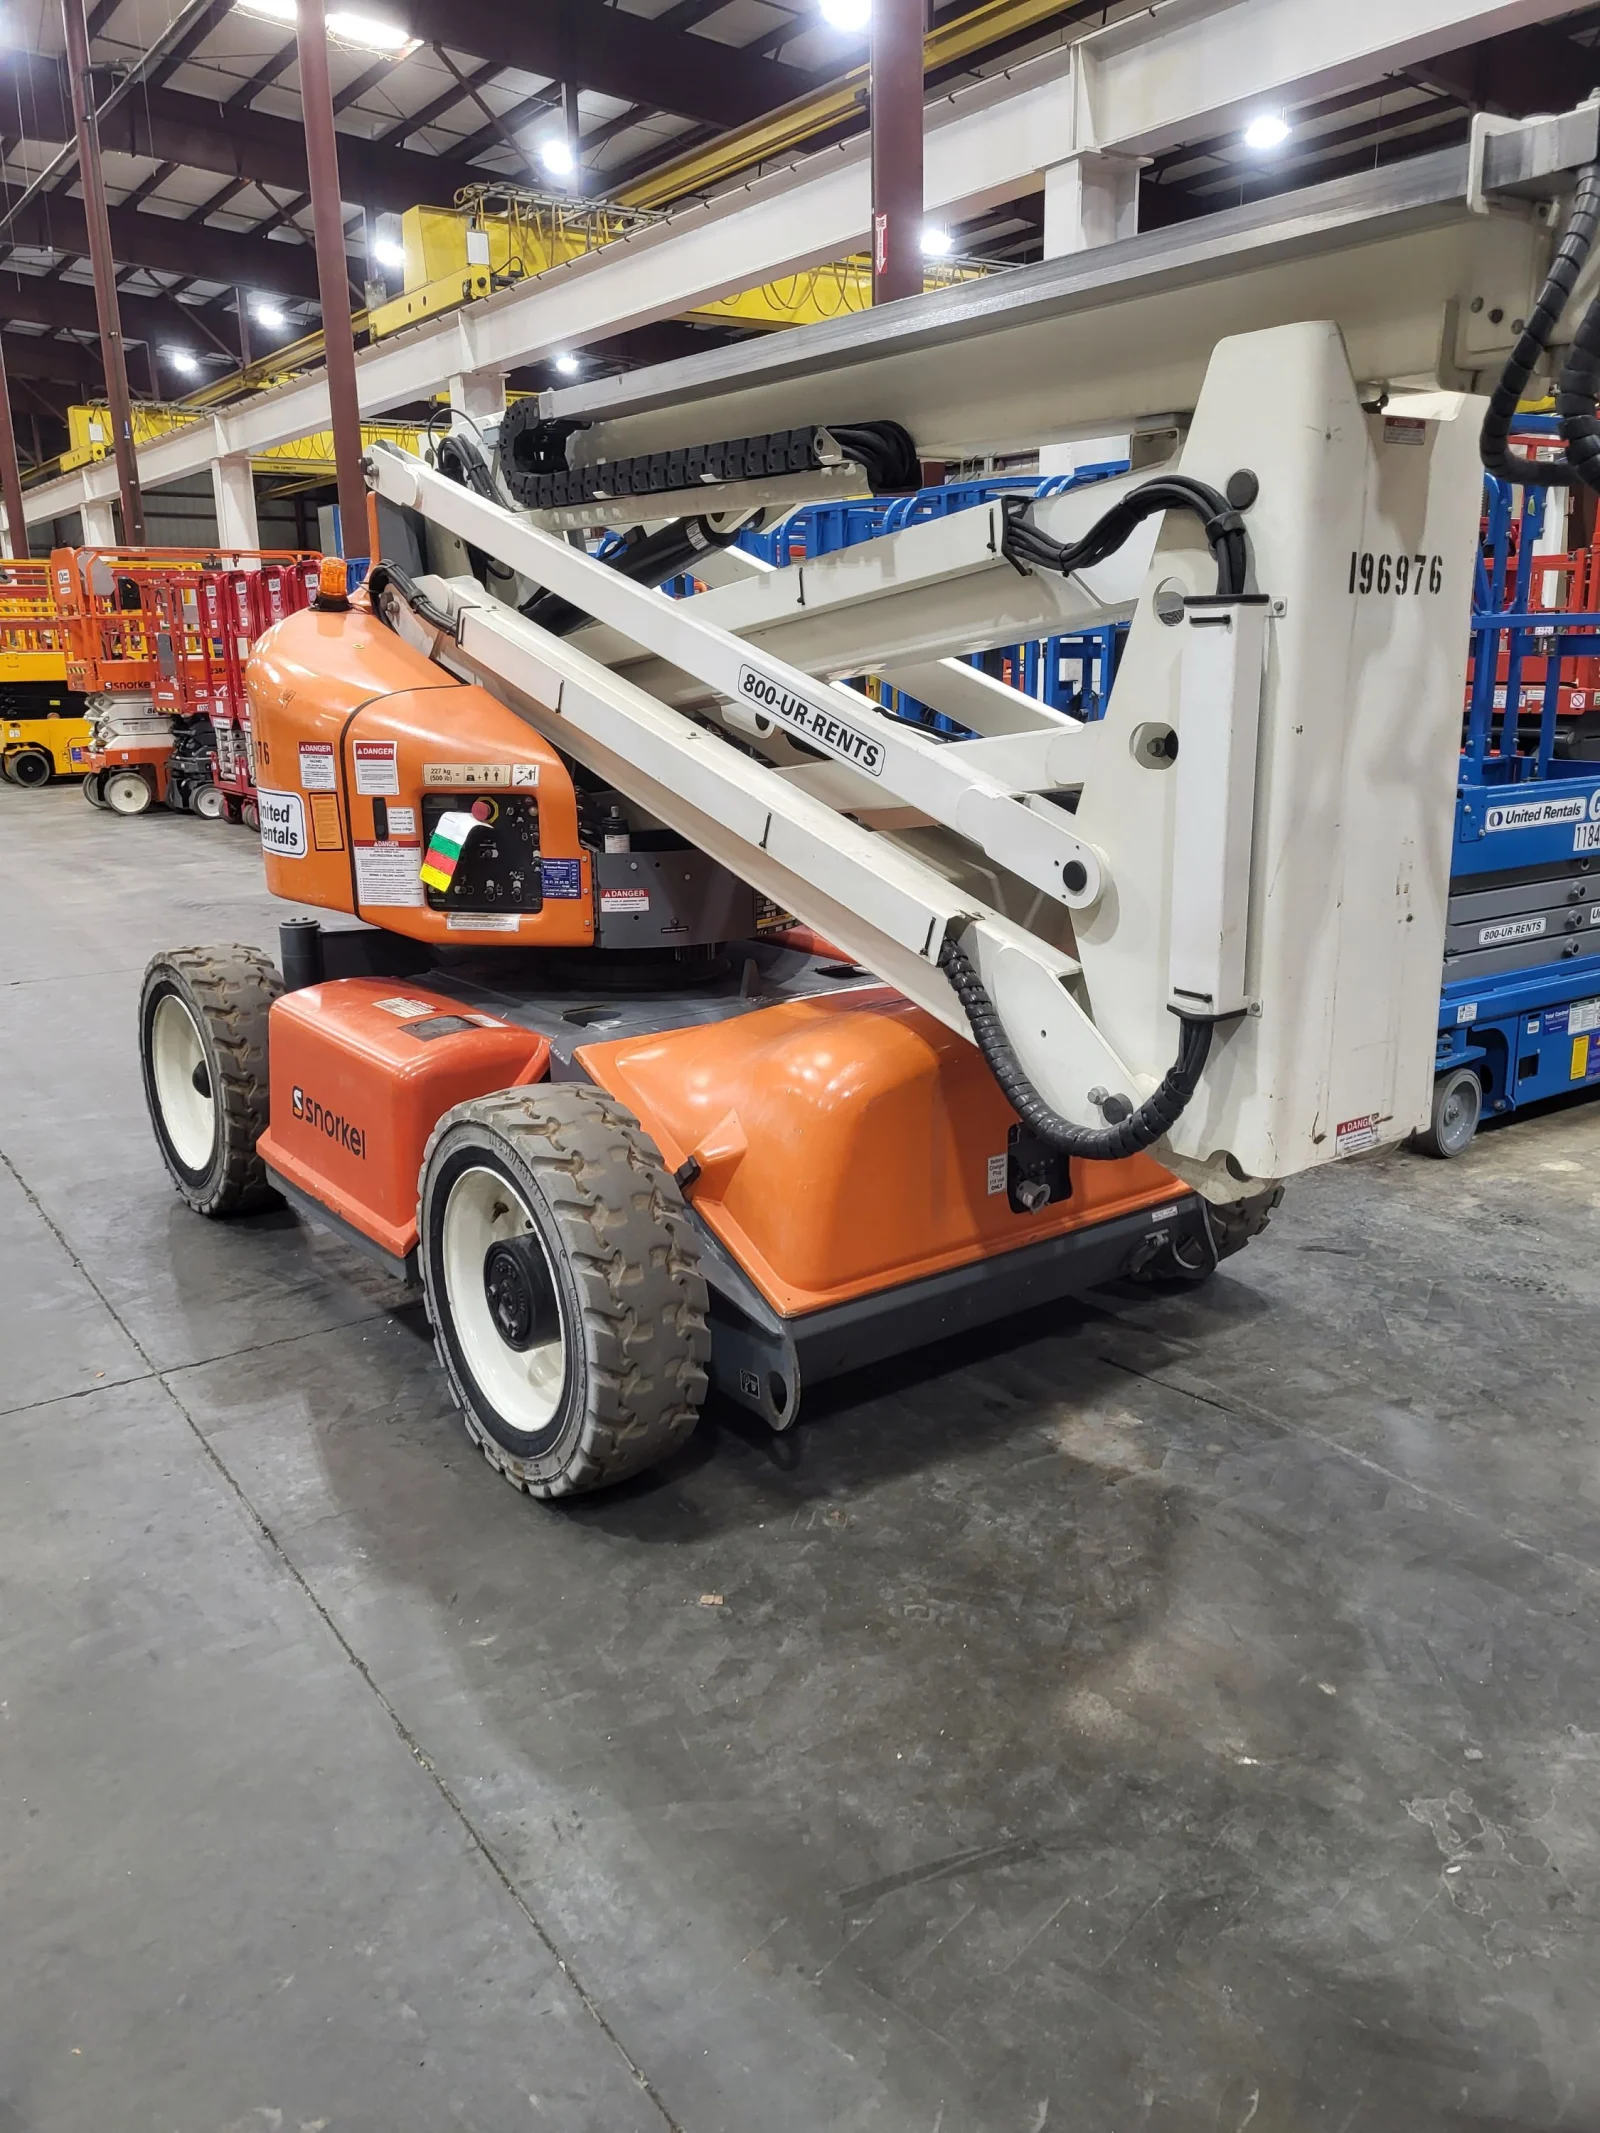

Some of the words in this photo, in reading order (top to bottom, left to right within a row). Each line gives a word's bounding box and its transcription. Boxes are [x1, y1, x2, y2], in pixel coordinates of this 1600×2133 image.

[1348, 551, 1443, 596] 196976
[113, 681, 151, 689] snorke
[743, 673, 879, 767] 800-UR-RENTS
[305, 744, 332, 752] DANGER
[429, 774, 443, 782] (500
[261, 801, 290, 823] nited
[1505, 808, 1541, 824] United
[1543, 802, 1581, 820] Rentals
[611, 890, 645, 898] DANGER
[1483, 921, 1542, 940] 800-UR-RENTS
[305, 1097, 366, 1160] snorkel
